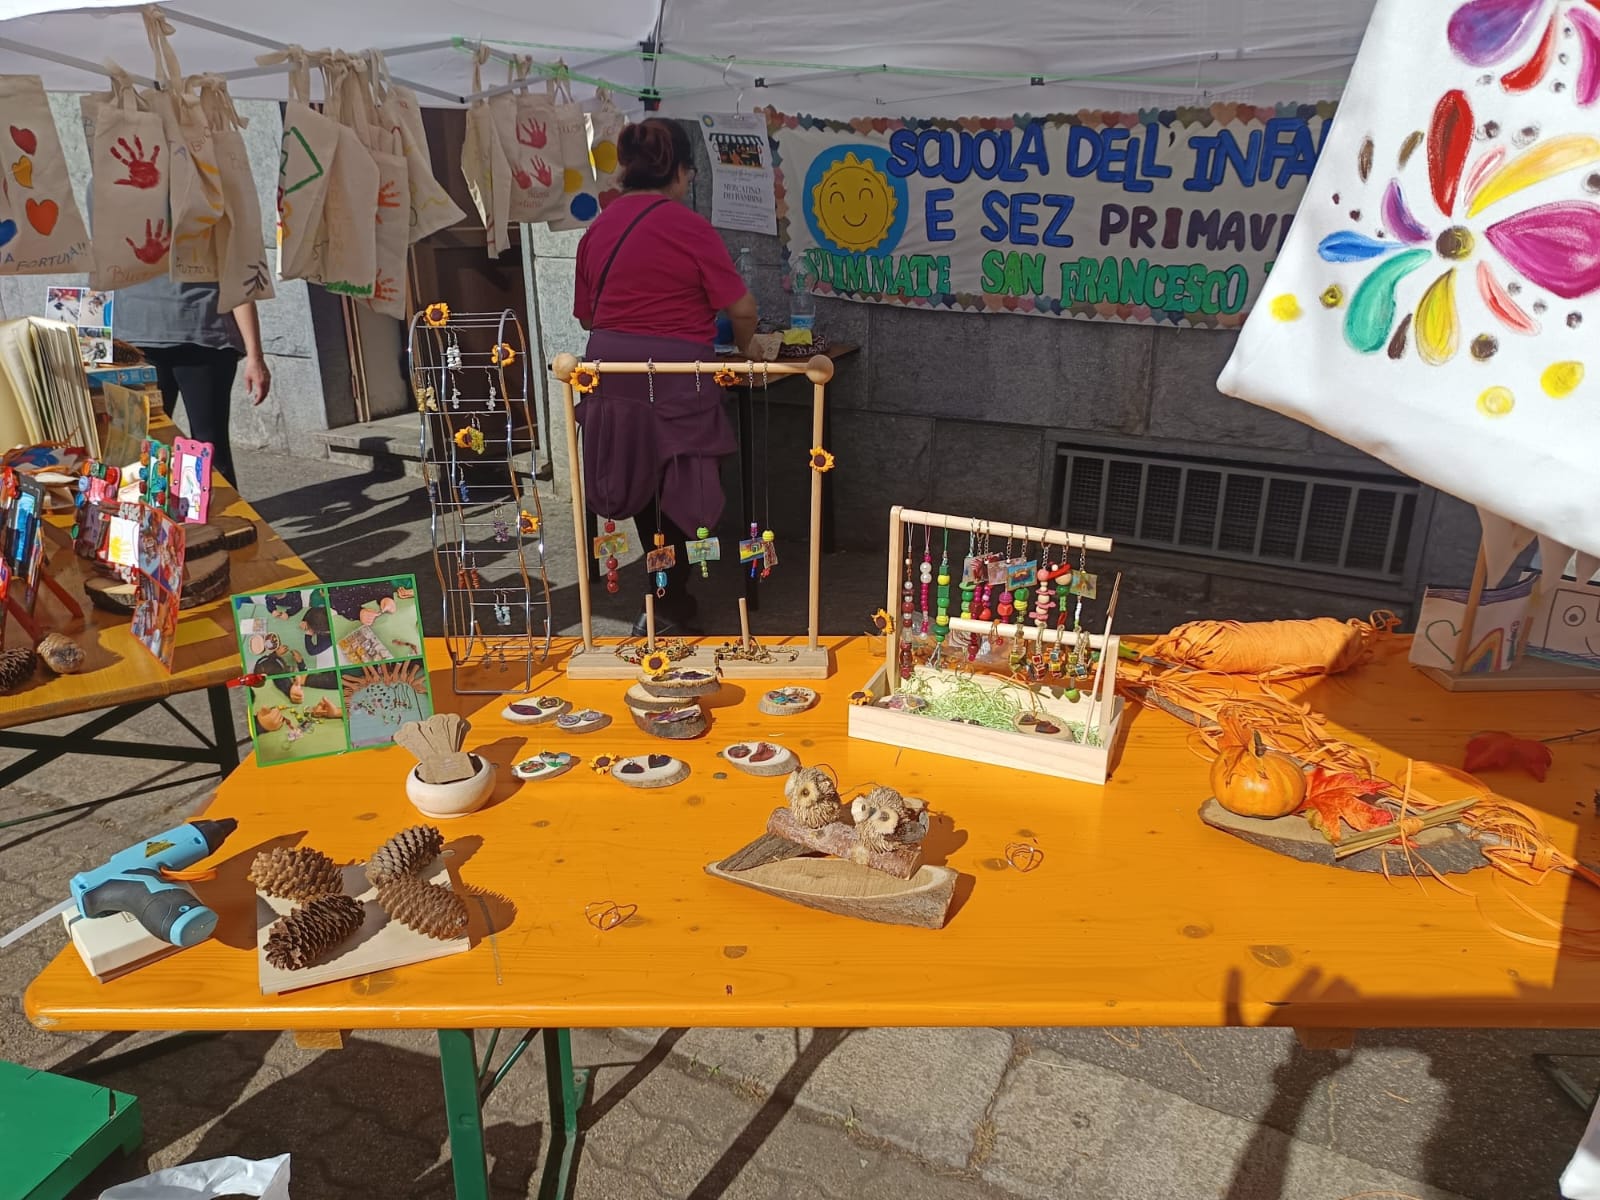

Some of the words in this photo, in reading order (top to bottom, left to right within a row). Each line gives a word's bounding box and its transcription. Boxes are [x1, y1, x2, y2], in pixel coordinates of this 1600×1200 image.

[886, 122, 1050, 183] SCUOLA
[925, 188, 956, 242] E
[980, 189, 1075, 248] SEZ
[804, 248, 951, 297] STIMMATE
[981, 249, 1047, 295] SAN
[1060, 255, 1249, 314] FRANCESCO
